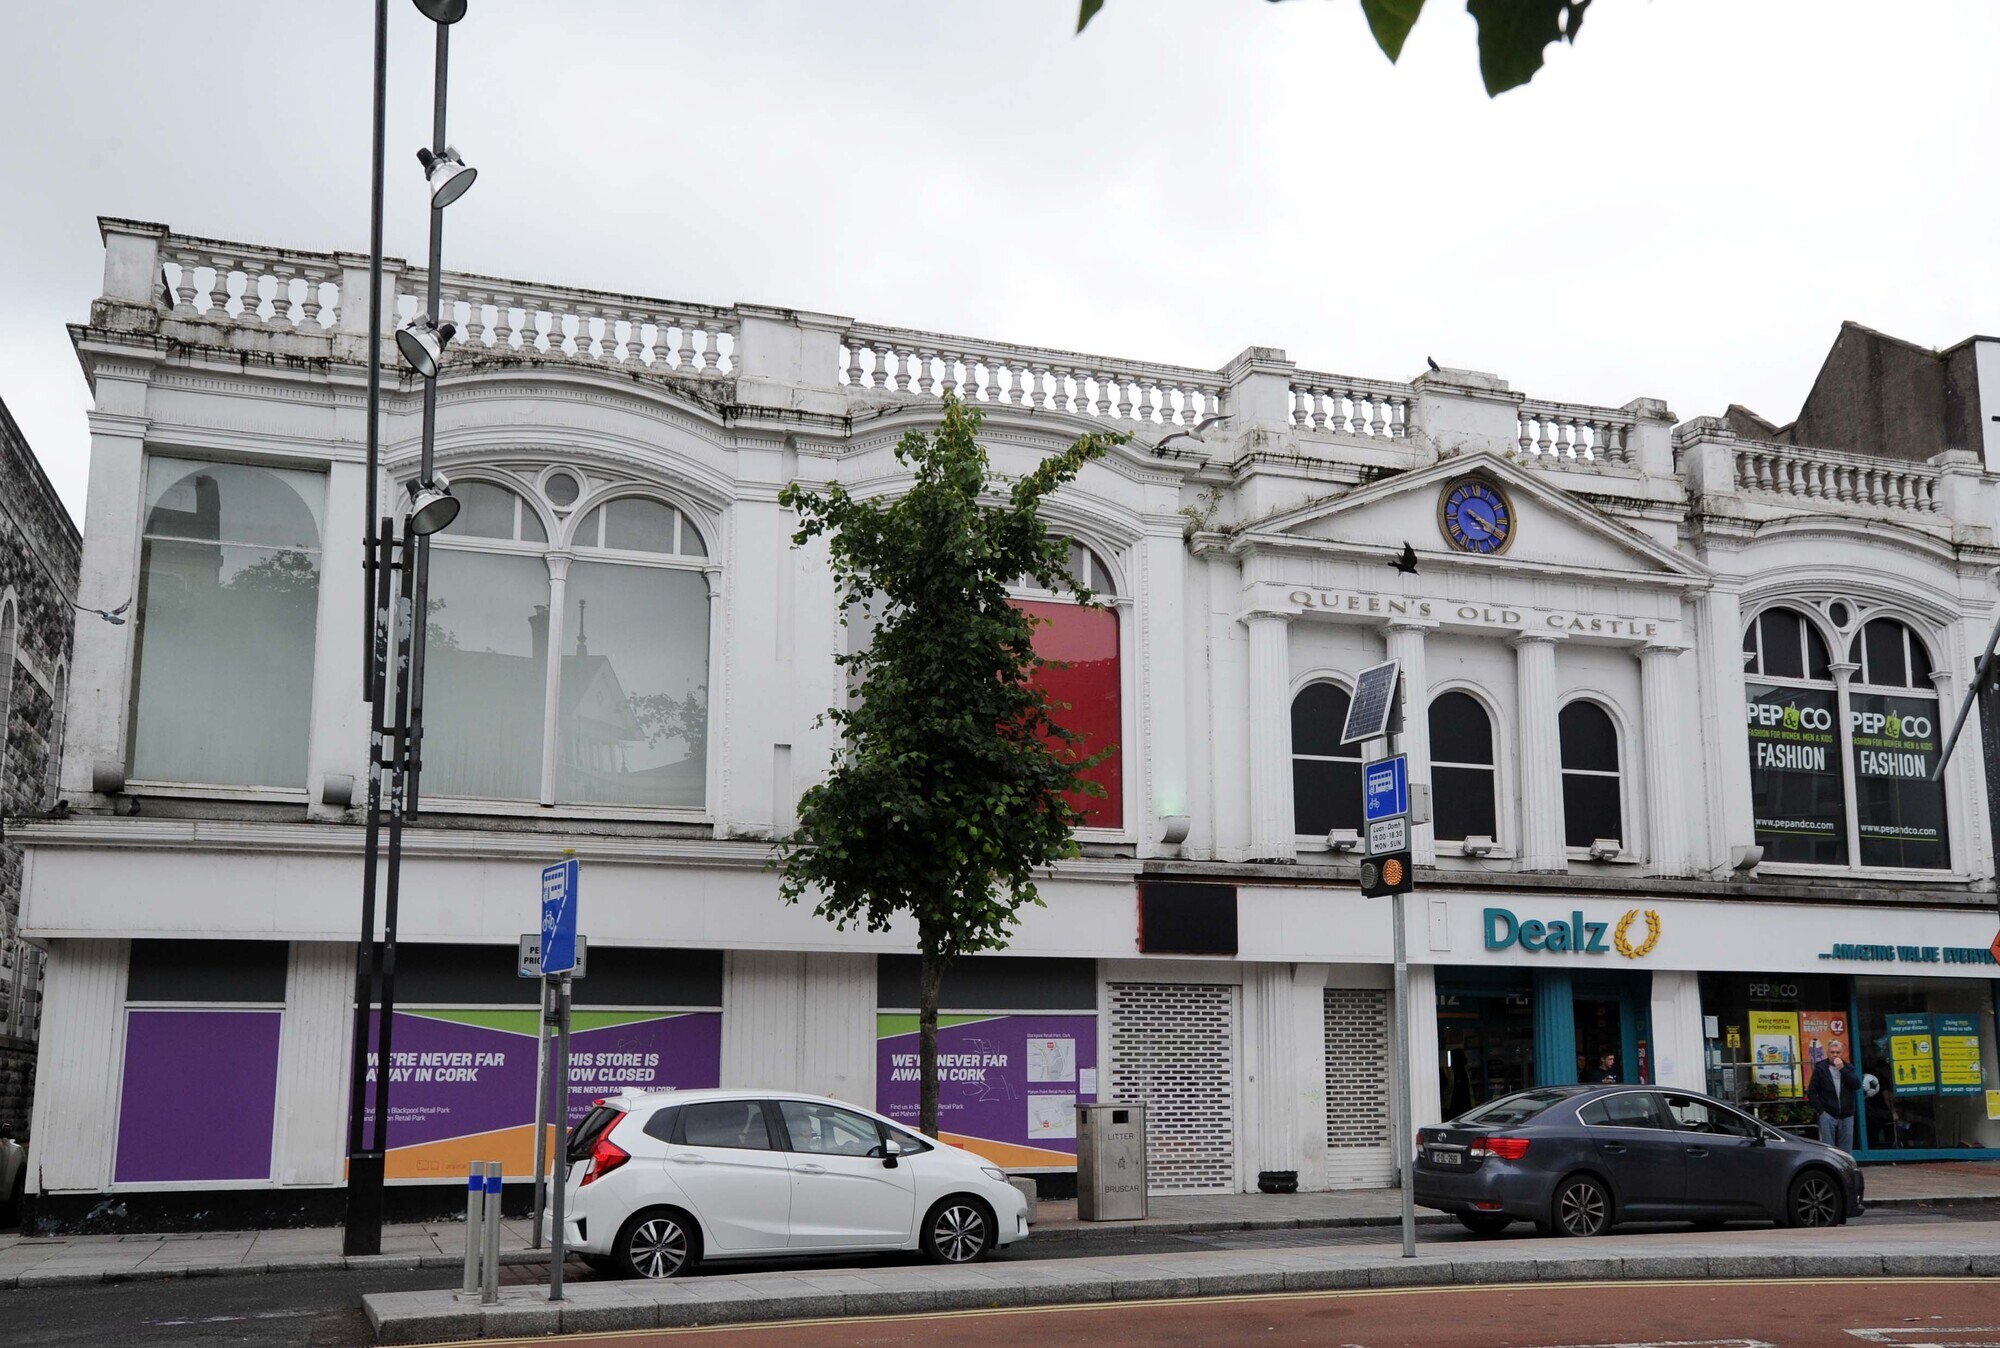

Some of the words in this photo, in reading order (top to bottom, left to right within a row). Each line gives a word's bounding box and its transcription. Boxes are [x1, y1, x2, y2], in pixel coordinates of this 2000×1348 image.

[1289, 590, 1431, 616] QUEEN'S
[1457, 606, 1521, 624] OLD
[1546, 615, 1658, 637] CASTLE
[1771, 731, 1782, 739] FOR
[1803, 733, 1815, 741] MEN
[1821, 735, 1833, 743] KIDS
[1873, 738, 1882, 746] FOR
[1903, 741, 1915, 749] MEN
[1920, 742, 1933, 750] KIDS
[1757, 742, 1825, 770] FASHION
[1860, 750, 1926, 777] FASHION
[1755, 818, 1834, 830] www.pepandco.com
[1860, 824, 1937, 836] www.pepandco.com
[1483, 907, 1610, 953] Dealz
[1897, 945, 1940, 962] VALUE
[1943, 947, 1996, 964] EVERYD
[1830, 1021, 1844, 1032] €2
[367, 1053, 418, 1066] W'RE
[420, 1053, 473, 1066] NEVER
[475, 1053, 505, 1066] FAR
[568, 1053, 593, 1066] HIS
[595, 1053, 643, 1066] STORE
[644, 1053, 659, 1066] IS
[937, 1054, 980, 1067] NEVER
[982, 1054, 1008, 1067] FAR
[415, 1068, 432, 1081] IN
[435, 1068, 479, 1082] CORK
[568, 1068, 596, 1081] OW
[598, 1068, 656, 1082] CLOSED
[891, 1068, 921, 1081] AWA
[937, 1068, 947, 1081] N
[950, 1068, 987, 1081] CORK
[567, 1086, 582, 1094] E'RE
[583, 1086, 609, 1094] NEVER
[391, 1107, 418, 1115] Blackpool
[1105, 1185, 1139, 1193] BRUSCAR
